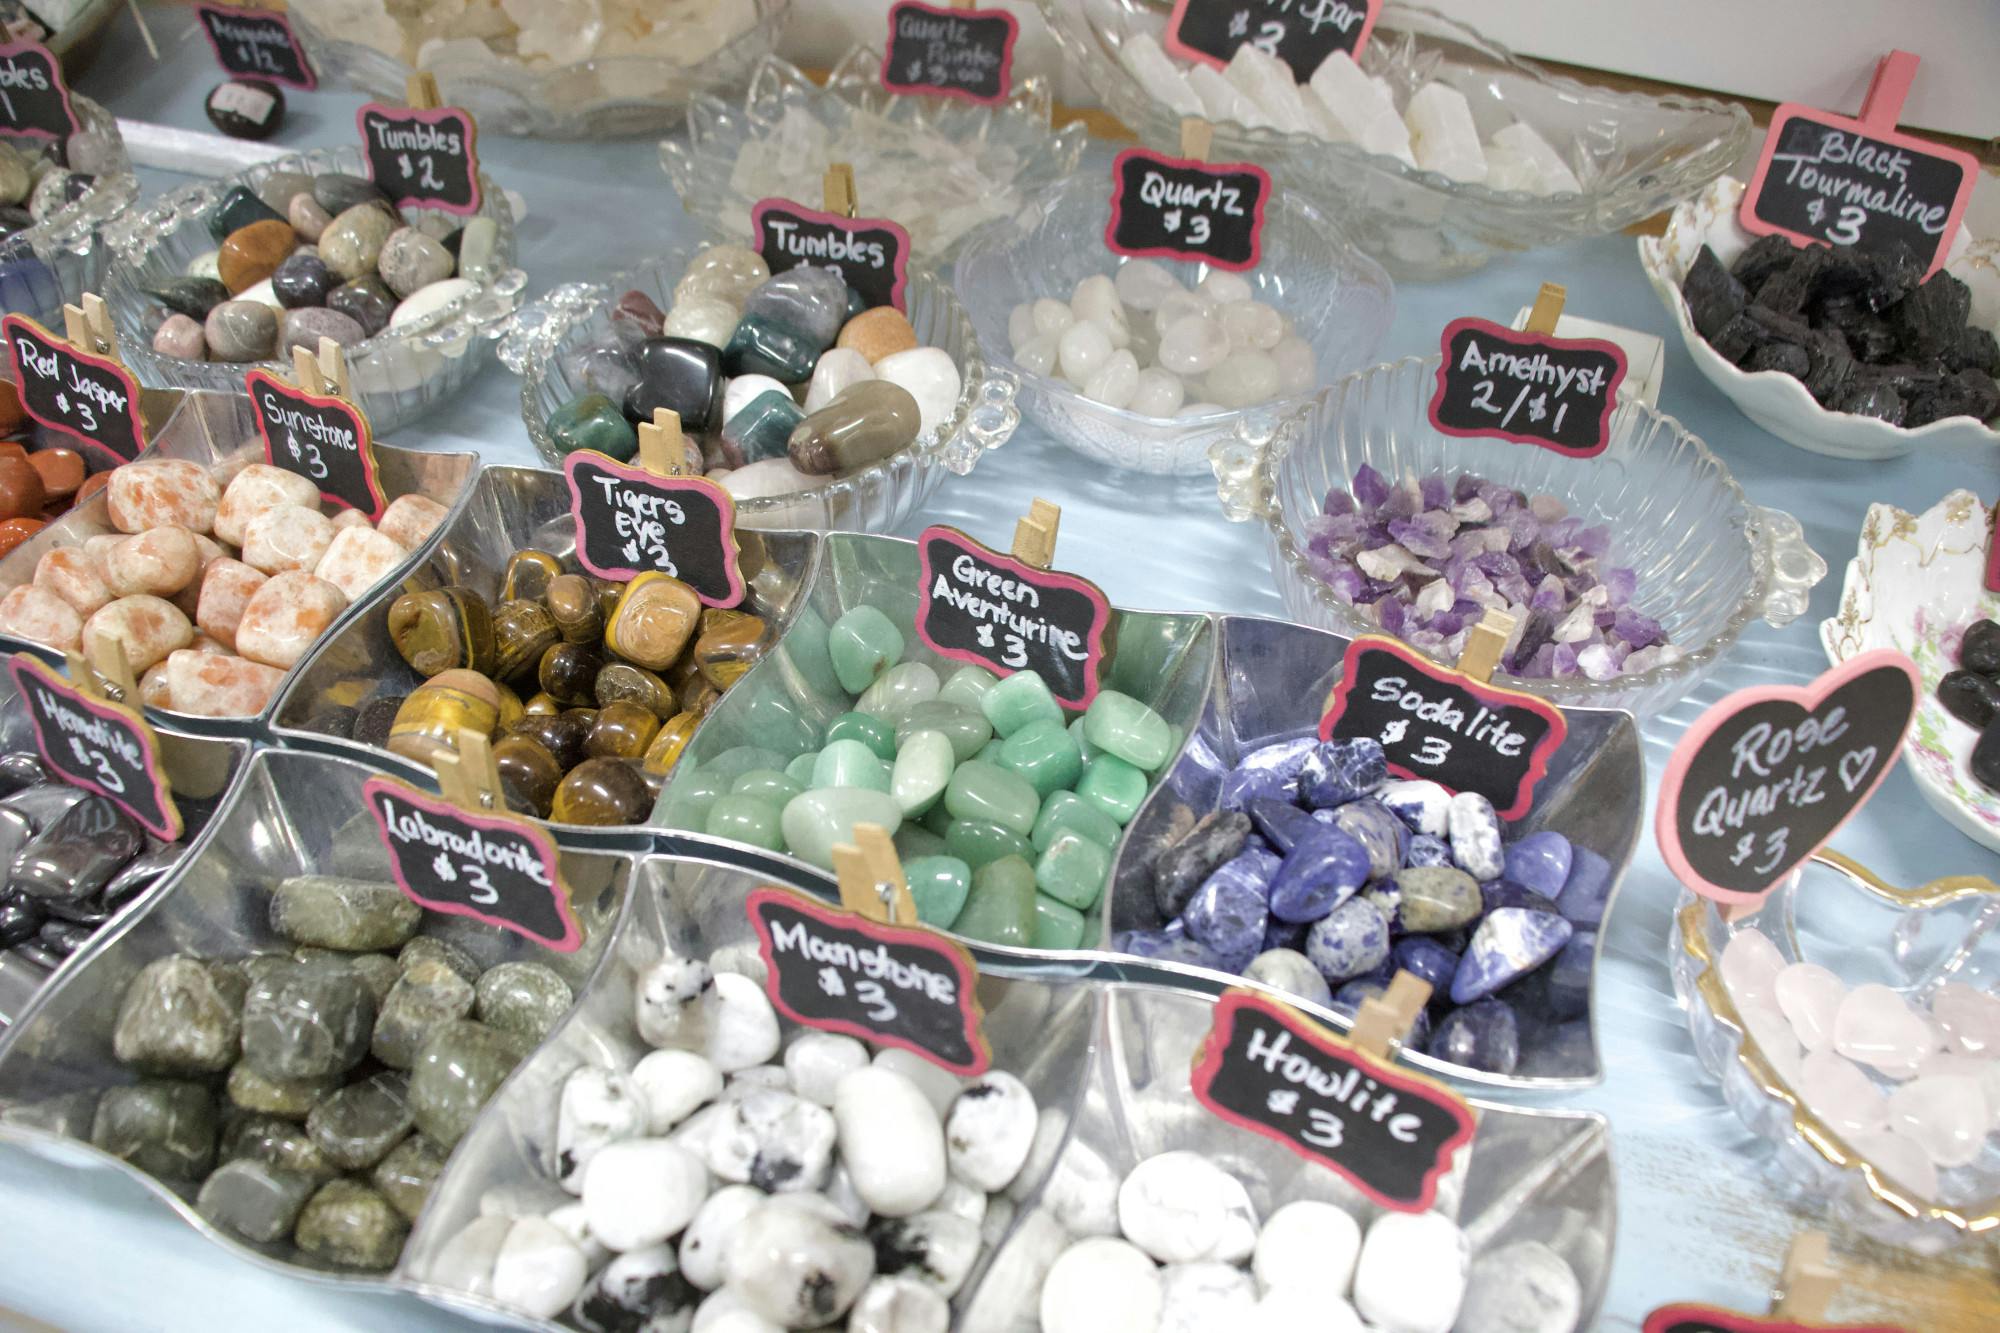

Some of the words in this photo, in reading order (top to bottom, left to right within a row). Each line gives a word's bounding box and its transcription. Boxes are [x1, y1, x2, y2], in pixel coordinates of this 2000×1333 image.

[369, 118, 461, 156] Tumbles
[1819, 131, 1912, 183] Black
[1140, 171, 1244, 217] Quartz
[1773, 151, 1948, 235] Tourmaline
[767, 219, 885, 269] Tumbles
[16, 337, 60, 382] Red
[1459, 339, 1606, 399] Amethyst
[263, 392, 357, 451] Sunstone
[591, 474, 686, 526] Tigers
[614, 510, 666, 550] Eye
[951, 554, 1040, 609] Green
[931, 573, 1090, 662] Aventurine
[1370, 676, 1527, 757] Sodalite
[1731, 705, 1850, 779] Rose
[1691, 763, 1828, 838] Quartz
[1245, 1027, 1423, 1144] Howlite
